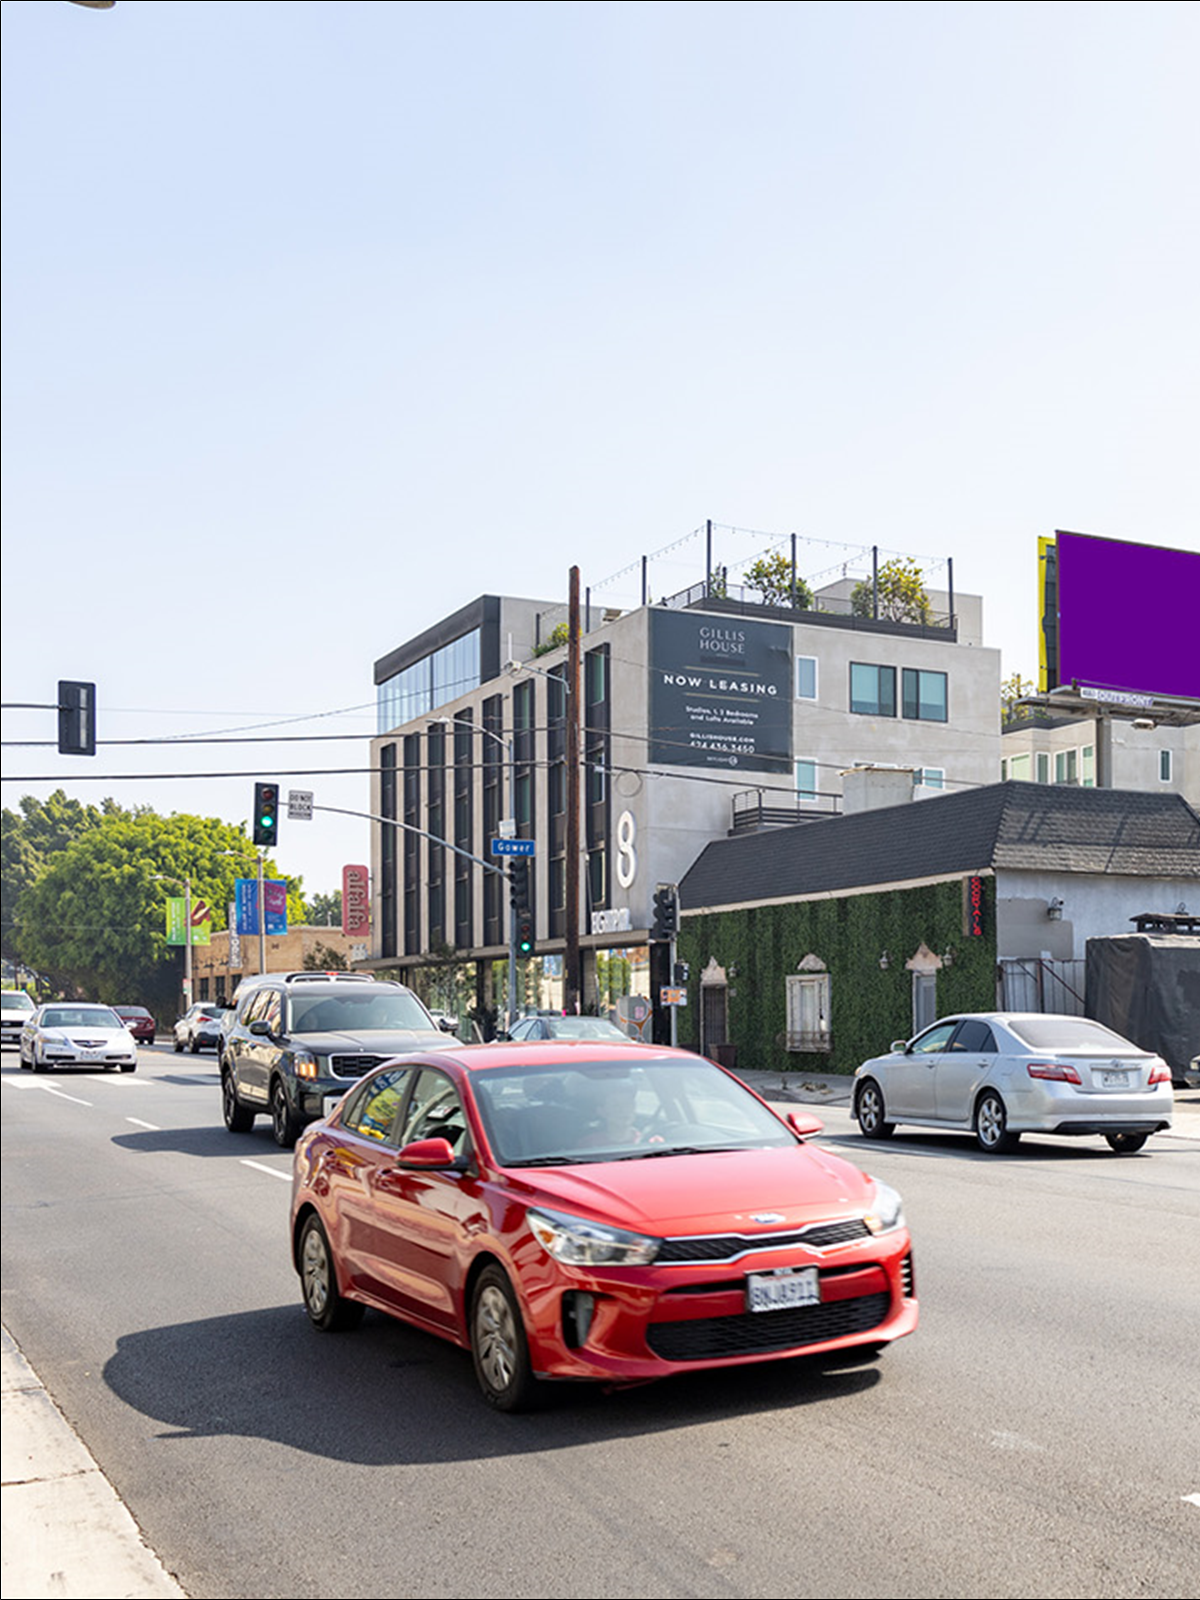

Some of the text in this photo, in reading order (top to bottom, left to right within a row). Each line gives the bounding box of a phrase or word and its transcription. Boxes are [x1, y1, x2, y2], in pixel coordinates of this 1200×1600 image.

[700, 627, 745, 642] GILLIS
[700, 640, 745, 654] HOUSE
[663, 674, 777, 695] NOW LEASING
[497, 842, 530, 852] Gower
[617, 810, 636, 888] 8
[347, 870, 367, 931] alfalfa
